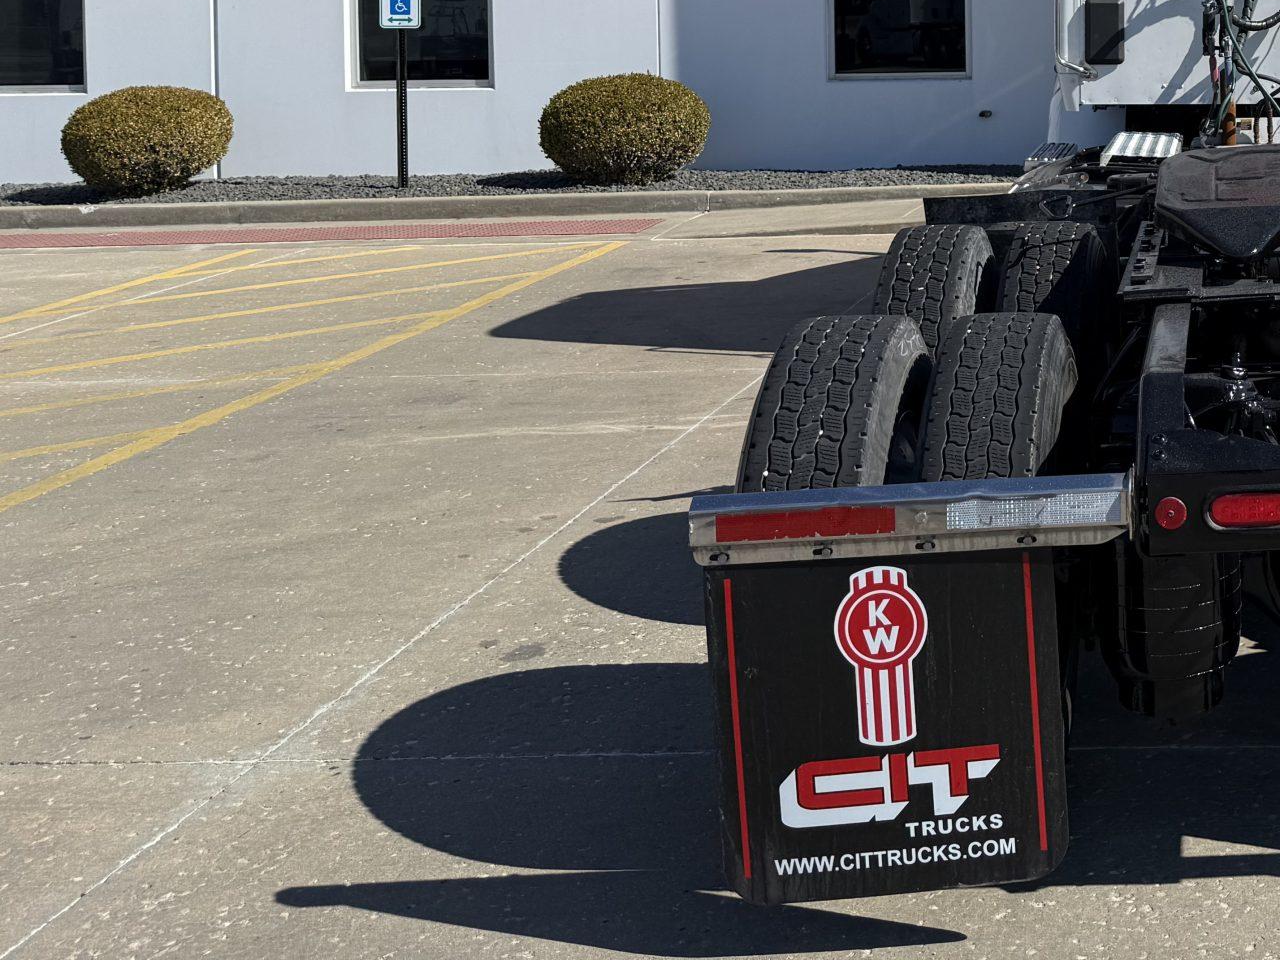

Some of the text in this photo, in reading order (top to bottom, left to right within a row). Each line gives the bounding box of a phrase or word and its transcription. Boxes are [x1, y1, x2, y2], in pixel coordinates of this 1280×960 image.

[869, 599, 892, 626] K
[863, 625, 899, 655] W
[779, 743, 1001, 828] CIT
[905, 813, 1004, 838] TRUCKS
[774, 837, 1017, 876] WWW.CITTRUCKS.COM
